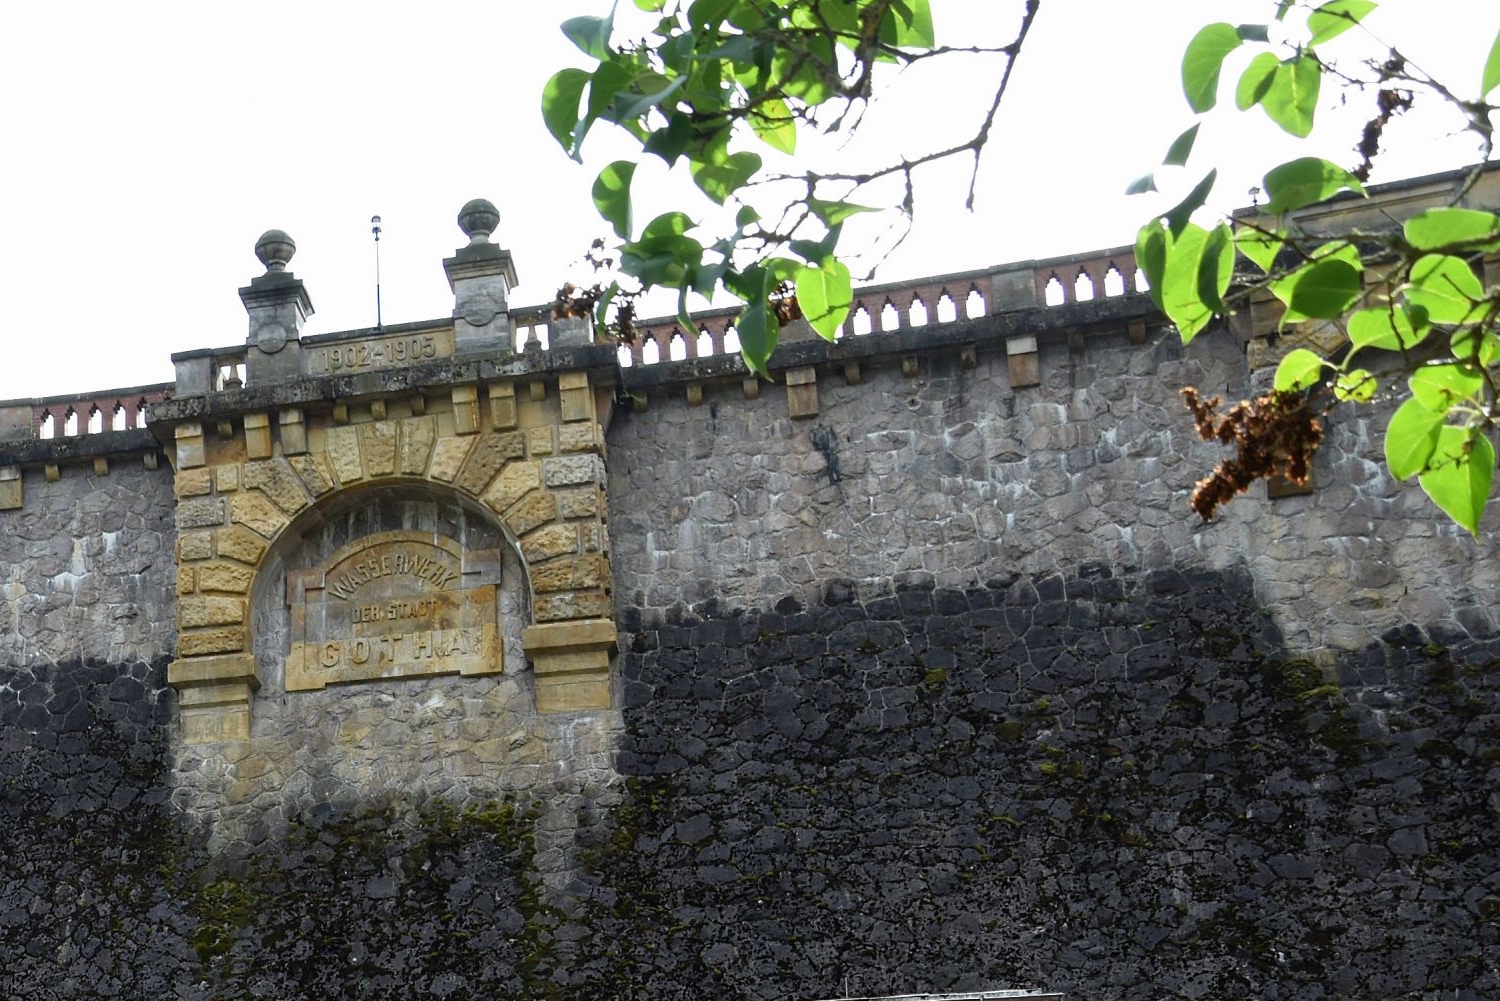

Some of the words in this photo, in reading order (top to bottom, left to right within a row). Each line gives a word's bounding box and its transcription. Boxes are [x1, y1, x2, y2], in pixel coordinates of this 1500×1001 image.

[328, 554, 458, 601] WASSERWERK
[352, 605, 382, 624] DER
[387, 600, 437, 621] STADT
[322, 628, 467, 667] GOTHA
